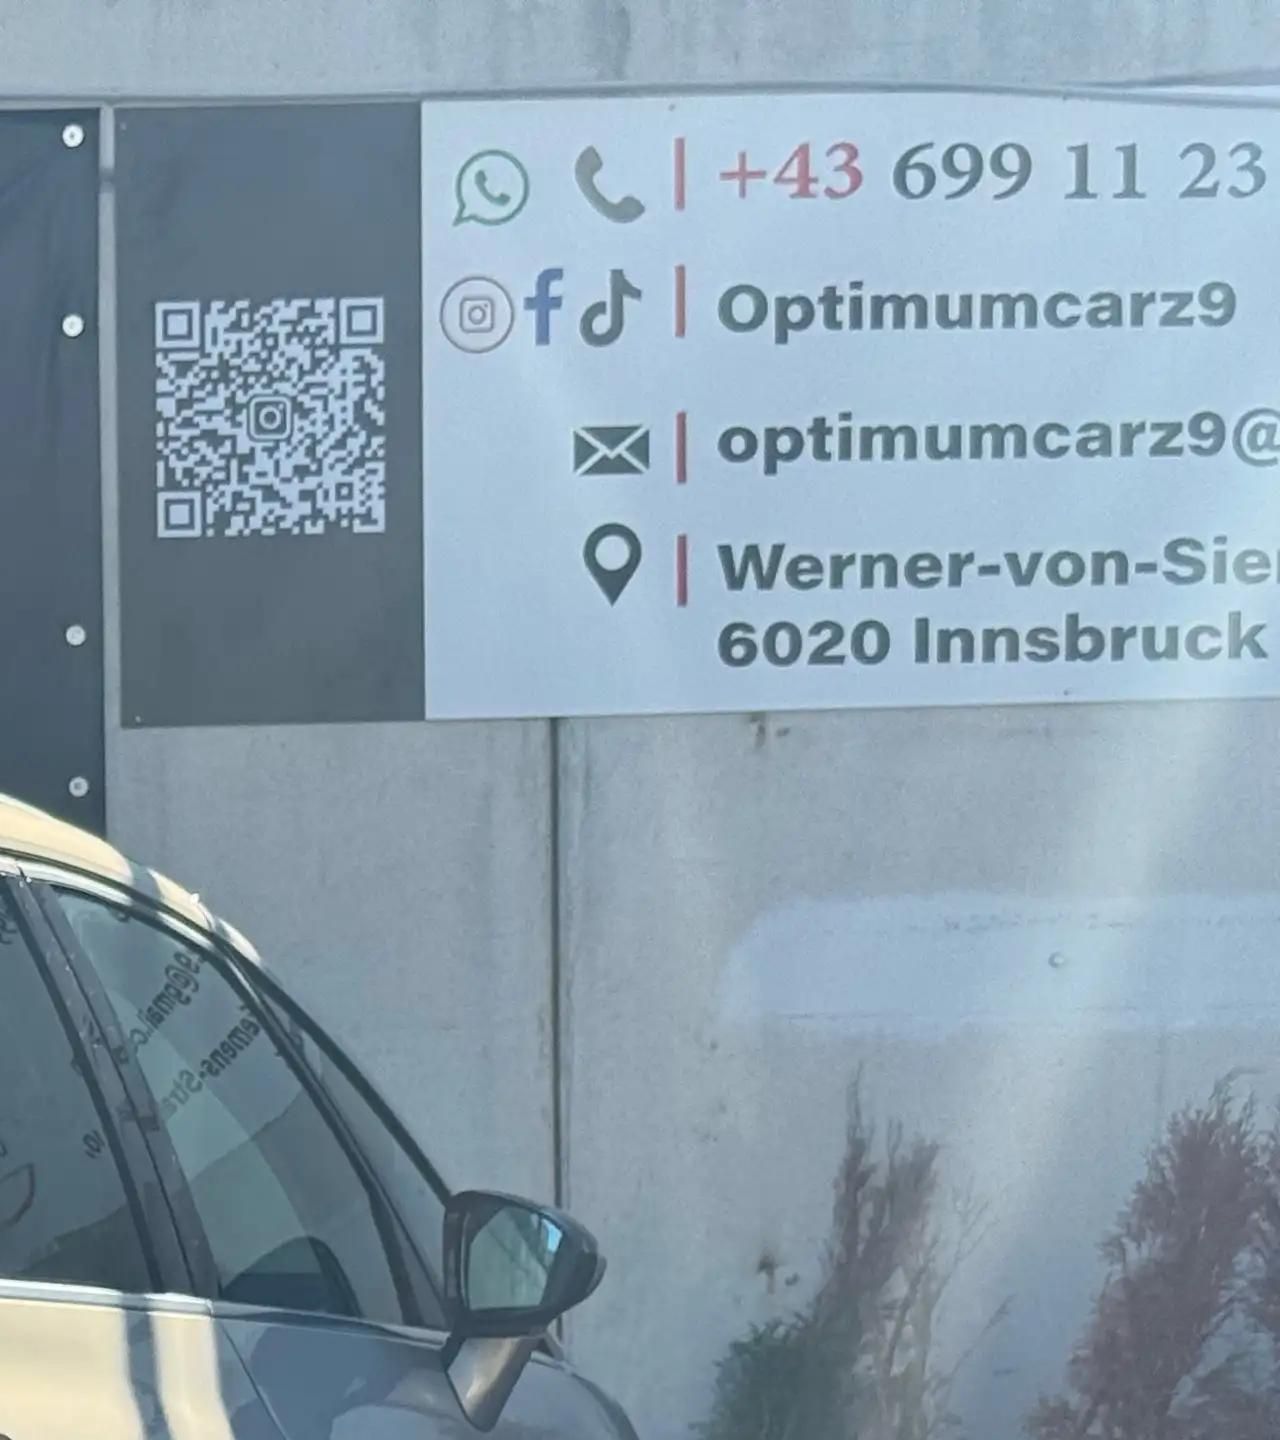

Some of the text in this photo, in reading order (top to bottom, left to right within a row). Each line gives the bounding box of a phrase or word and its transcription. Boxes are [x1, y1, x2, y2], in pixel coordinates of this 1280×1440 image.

[718, 141, 1267, 200] +43 699 11 23
[717, 281, 1238, 345] Optimumcarz9
[717, 534, 1280, 591] Werner-von-Sie
[717, 611, 1269, 668] 6020 Innsbruck
